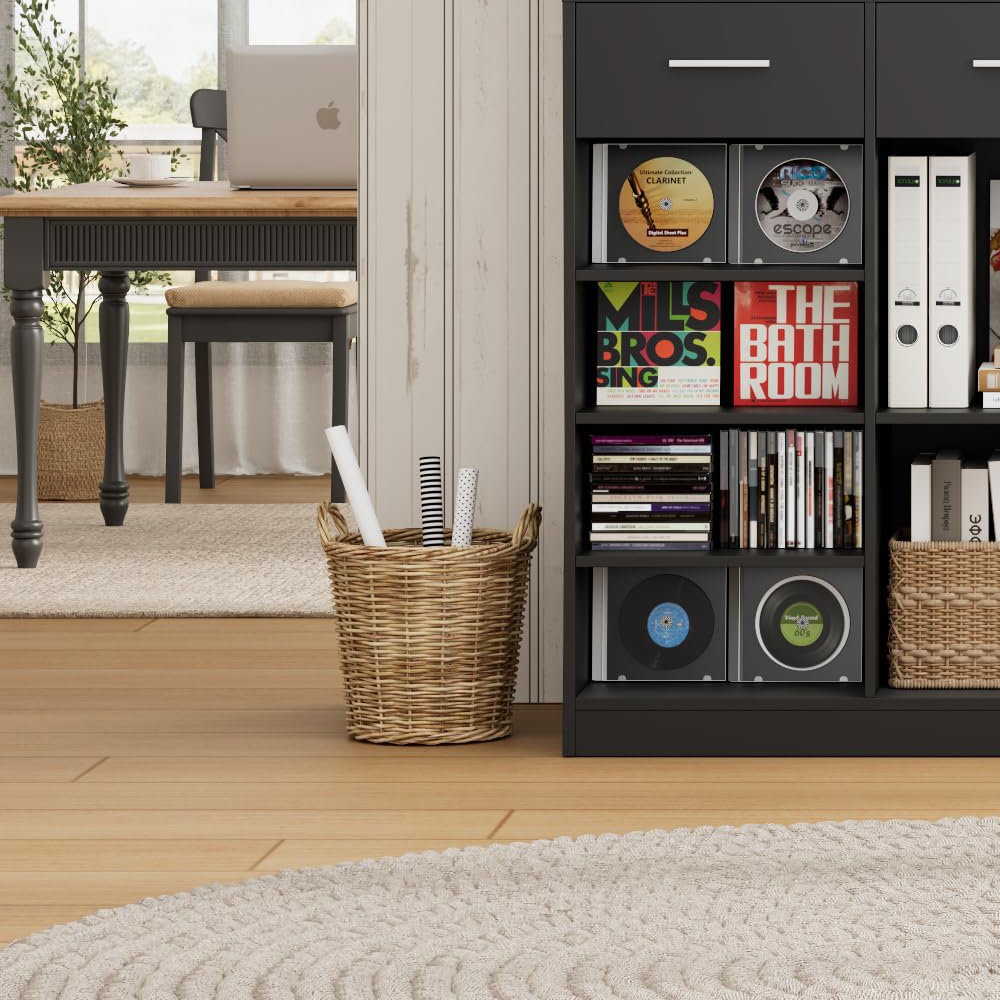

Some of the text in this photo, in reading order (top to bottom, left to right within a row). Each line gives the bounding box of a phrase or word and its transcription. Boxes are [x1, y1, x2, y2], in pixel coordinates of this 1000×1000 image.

[774, 224, 832, 238] escape
[597, 281, 721, 332] MILLS
[768, 284, 851, 324] THE
[597, 332, 716, 366] BROS.
[740, 324, 850, 362] BATH
[597, 367, 658, 388] SING
[740, 362, 849, 400] ROOM
